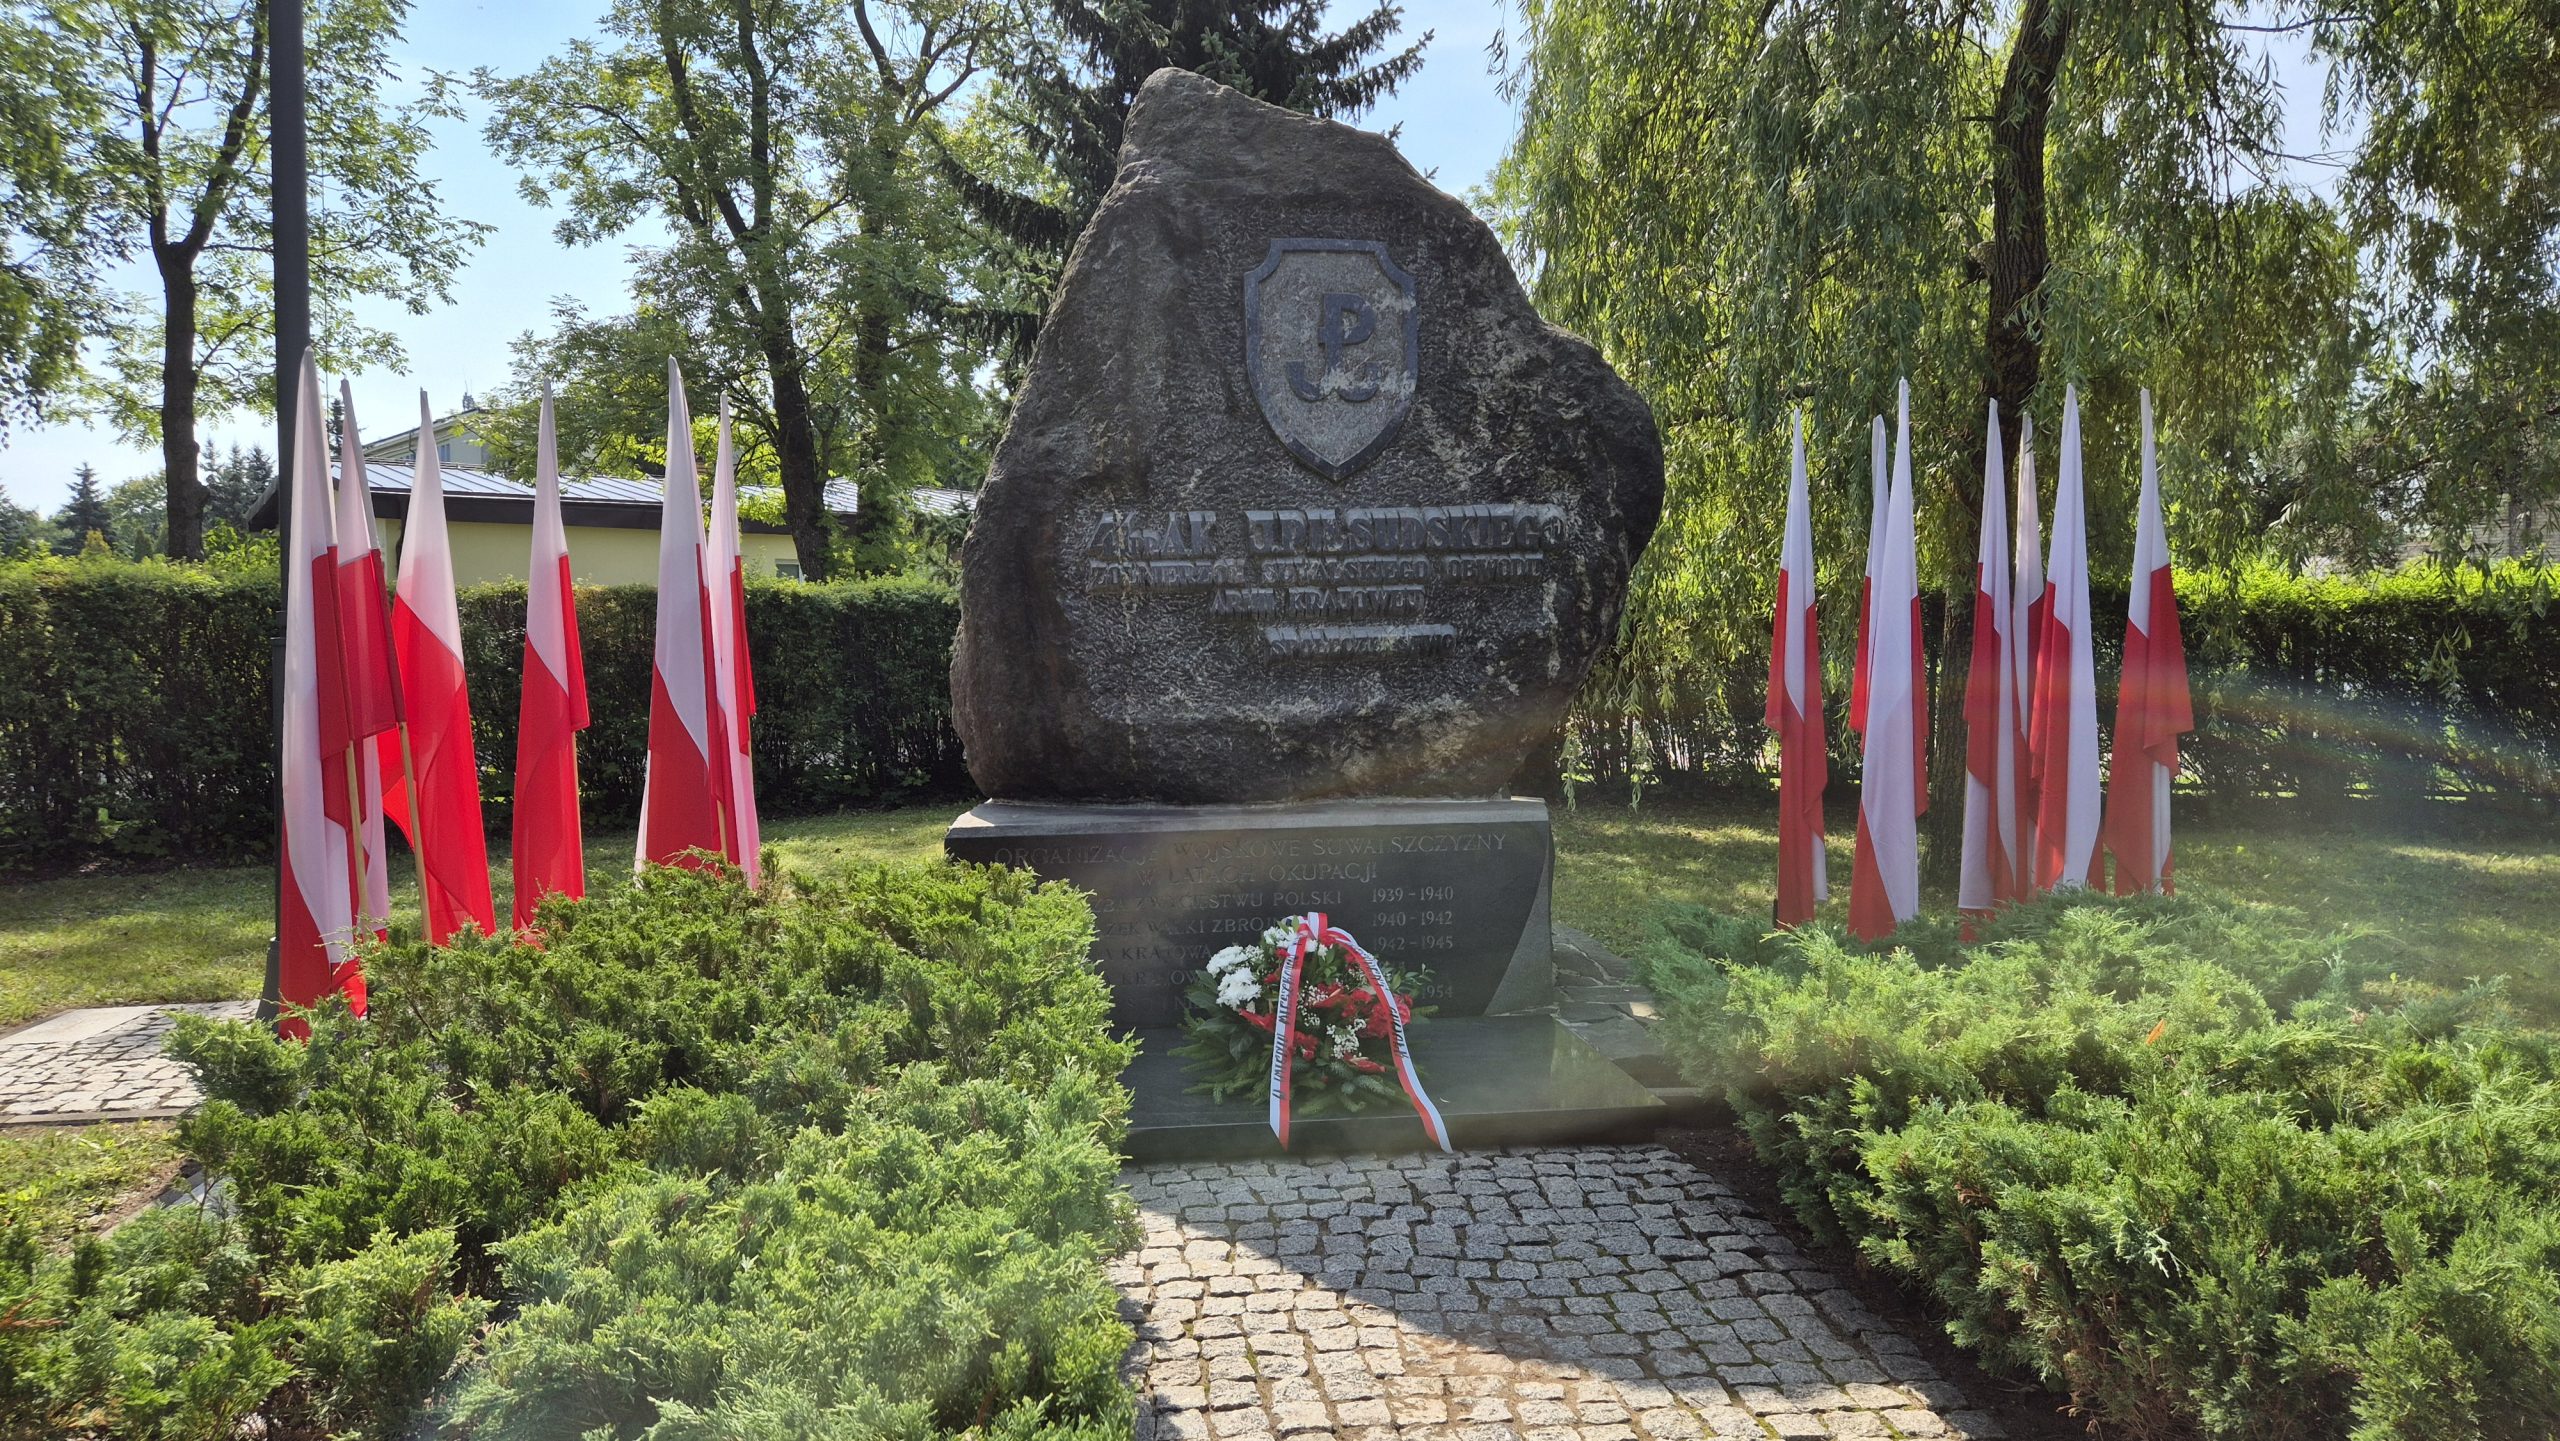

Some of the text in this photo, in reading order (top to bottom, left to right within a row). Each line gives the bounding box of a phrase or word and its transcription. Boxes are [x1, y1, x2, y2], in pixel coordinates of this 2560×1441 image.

[994, 833, 1506, 866] ORGANIZACJE WOJSKOWE SUWALSZCZYZNY
[1136, 861, 1377, 887] W LATACH OKUPACJI
[1273, 890, 1342, 907] POLSKI
[1211, 917, 1276, 933] ZBROJ
